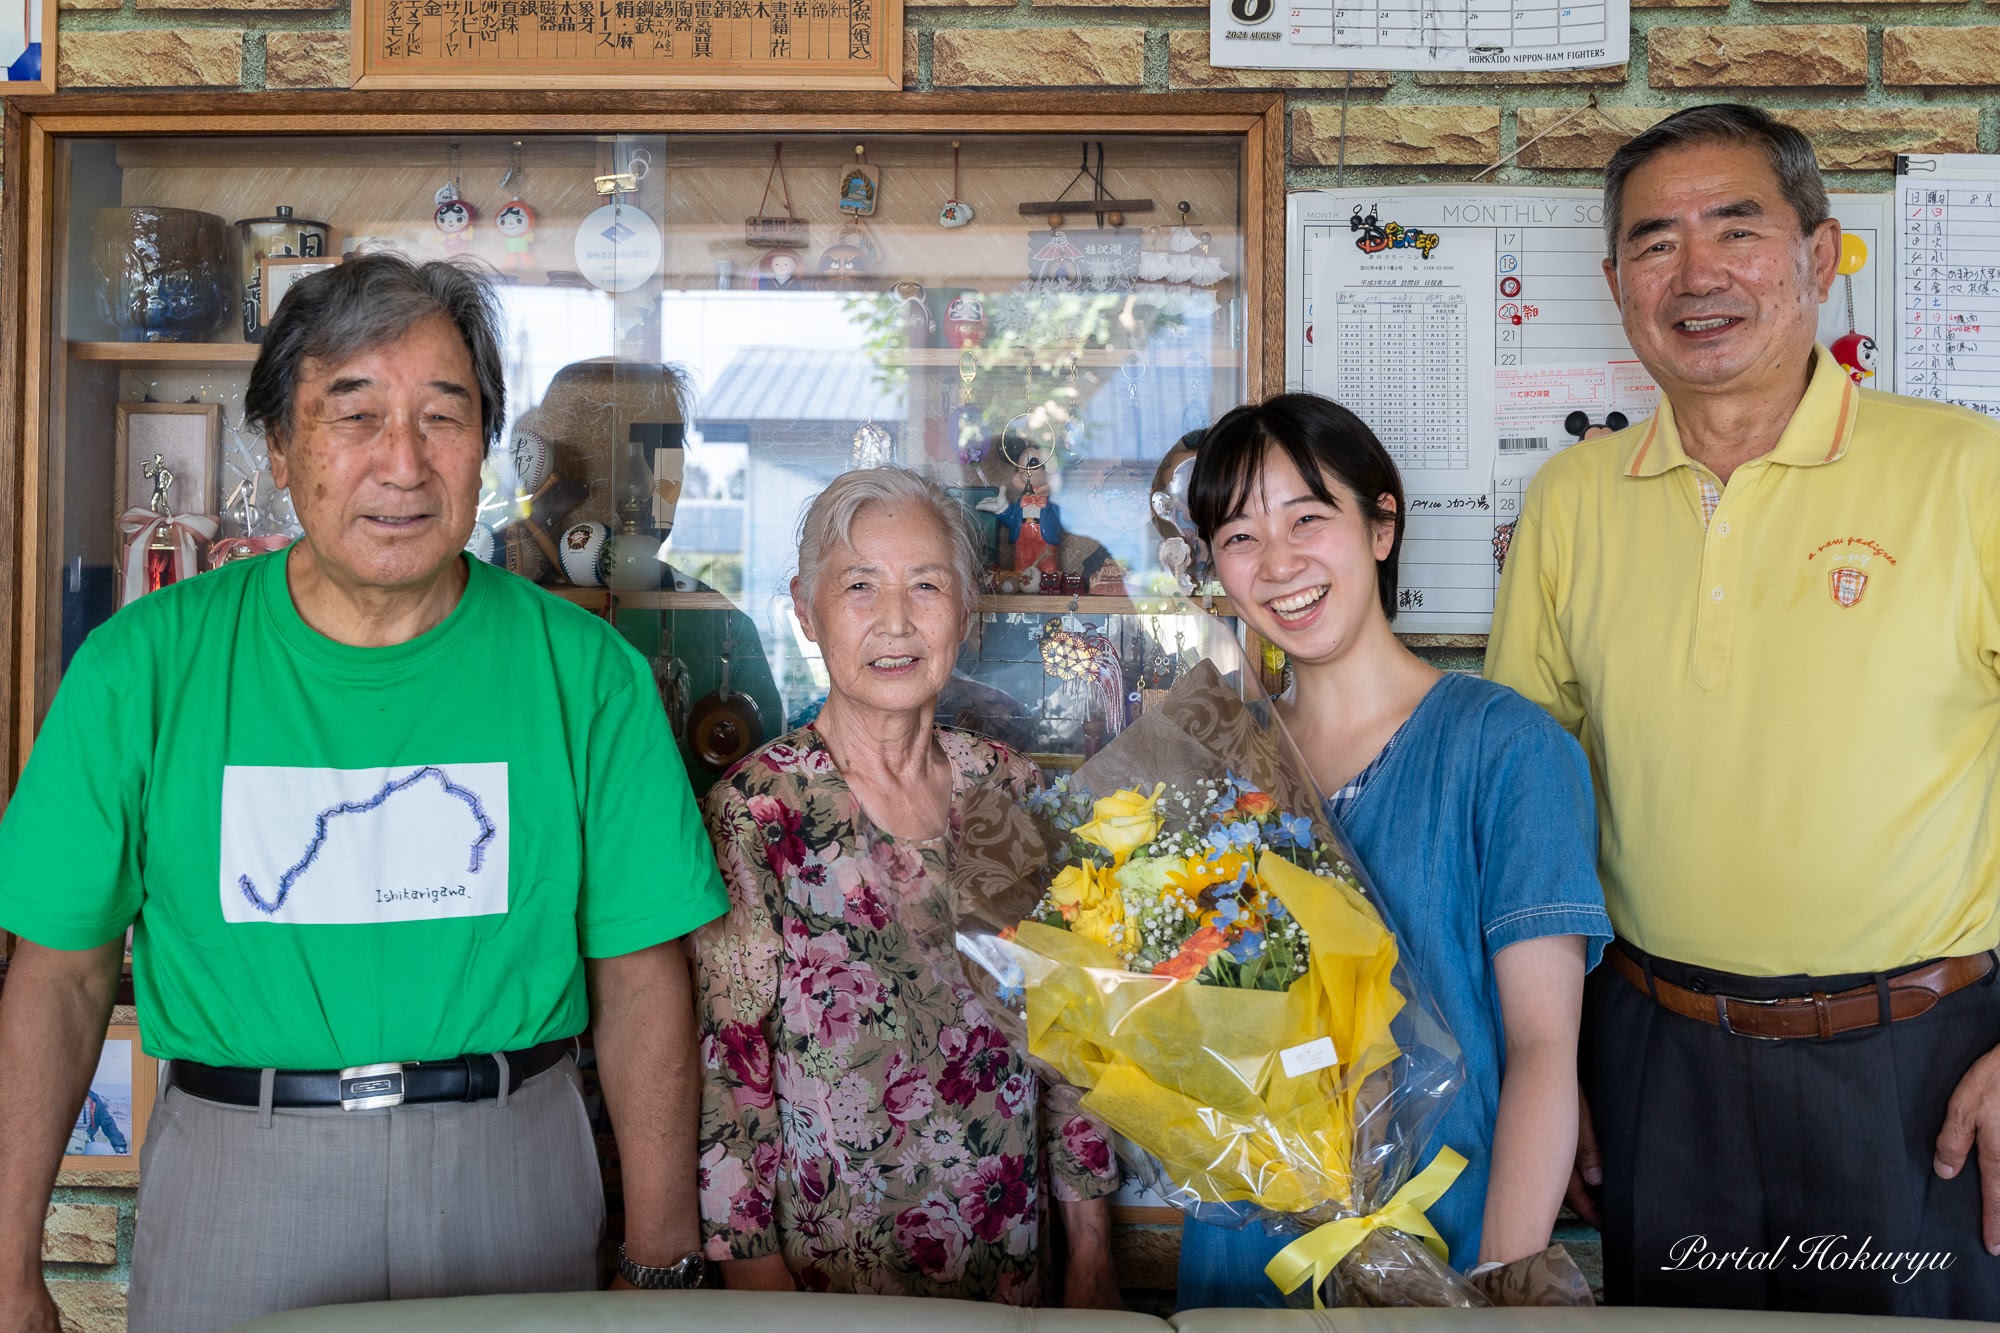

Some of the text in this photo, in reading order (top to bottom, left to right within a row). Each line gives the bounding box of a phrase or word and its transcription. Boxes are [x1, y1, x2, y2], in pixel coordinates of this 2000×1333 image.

[423, 0, 442, 16] 金
[520, 1, 538, 16] 銀
[539, 1, 557, 31] 磁器
[675, 1, 692, 31] 陶器
[713, 1, 731, 18] 銅
[733, 1, 751, 18] 鉄
[753, 1, 770, 18] 木
[792, 1, 808, 18] 革
[811, 1, 828, 19] 綿
[830, 1, 849, 18] 紙
[499, 1, 518, 35] 真珠
[558, 1, 576, 32] 水晶
[578, 1, 596, 34] 象牙
[597, 1, 615, 48] レース
[635, 1, 654, 34] 鋼鉄
[385, 1, 403, 56] ダイヤモンド
[405, 0, 422, 56] エメラルド
[462, 1, 480, 49] ルビー
[694, 1, 712, 57] 電気器具
[1225, 31, 1282, 41] 2021 AUGUST
[1469, 49, 1605, 64] HOKKAIDO NIPPON-HAM FIGHTERS
[1306, 211, 1339, 219] MONTH
[1443, 204, 1558, 224] MONTHLY
[1911, 221, 1941, 235] 2 月
[1503, 234, 1515, 245] 17
[1084, 243, 1122, 256] 桂沢湖
[1503, 258, 1516, 270] 18
[1914, 281, 1921, 291] 6
[1913, 297, 1941, 308] 7 土
[1502, 306, 1516, 318] 20
[1914, 312, 1921, 321] 8
[1502, 330, 1515, 341] 21
[1914, 326, 1922, 338] 9
[1501, 354, 1516, 365] 22
[1911, 374, 1924, 382] 12
[1911, 388, 1923, 397] 13
[1500, 498, 1515, 511] 28
